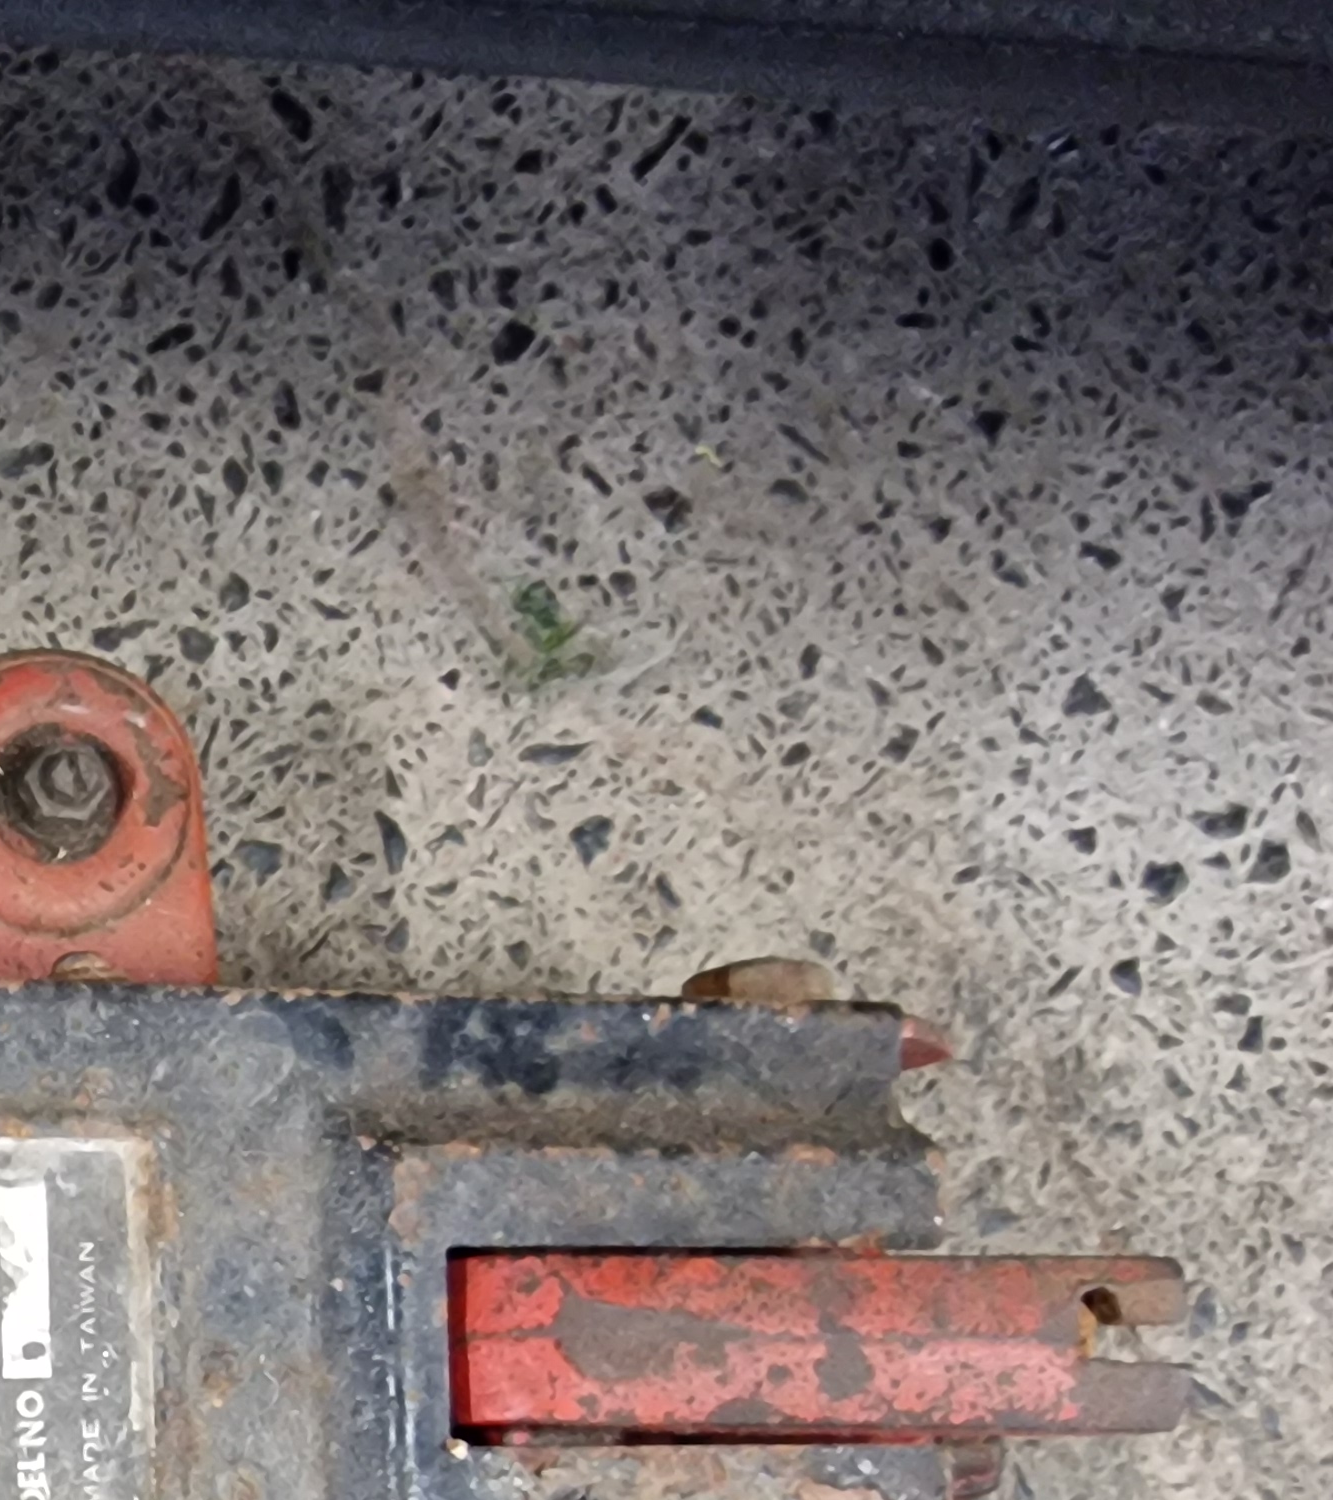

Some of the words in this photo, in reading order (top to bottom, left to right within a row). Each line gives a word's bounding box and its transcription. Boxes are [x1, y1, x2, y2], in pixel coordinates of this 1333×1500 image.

[77, 1241, 96, 1354] TAIWAN
[81, 1373, 98, 1401] IN
[16, 1389, 45, 1446] NO
